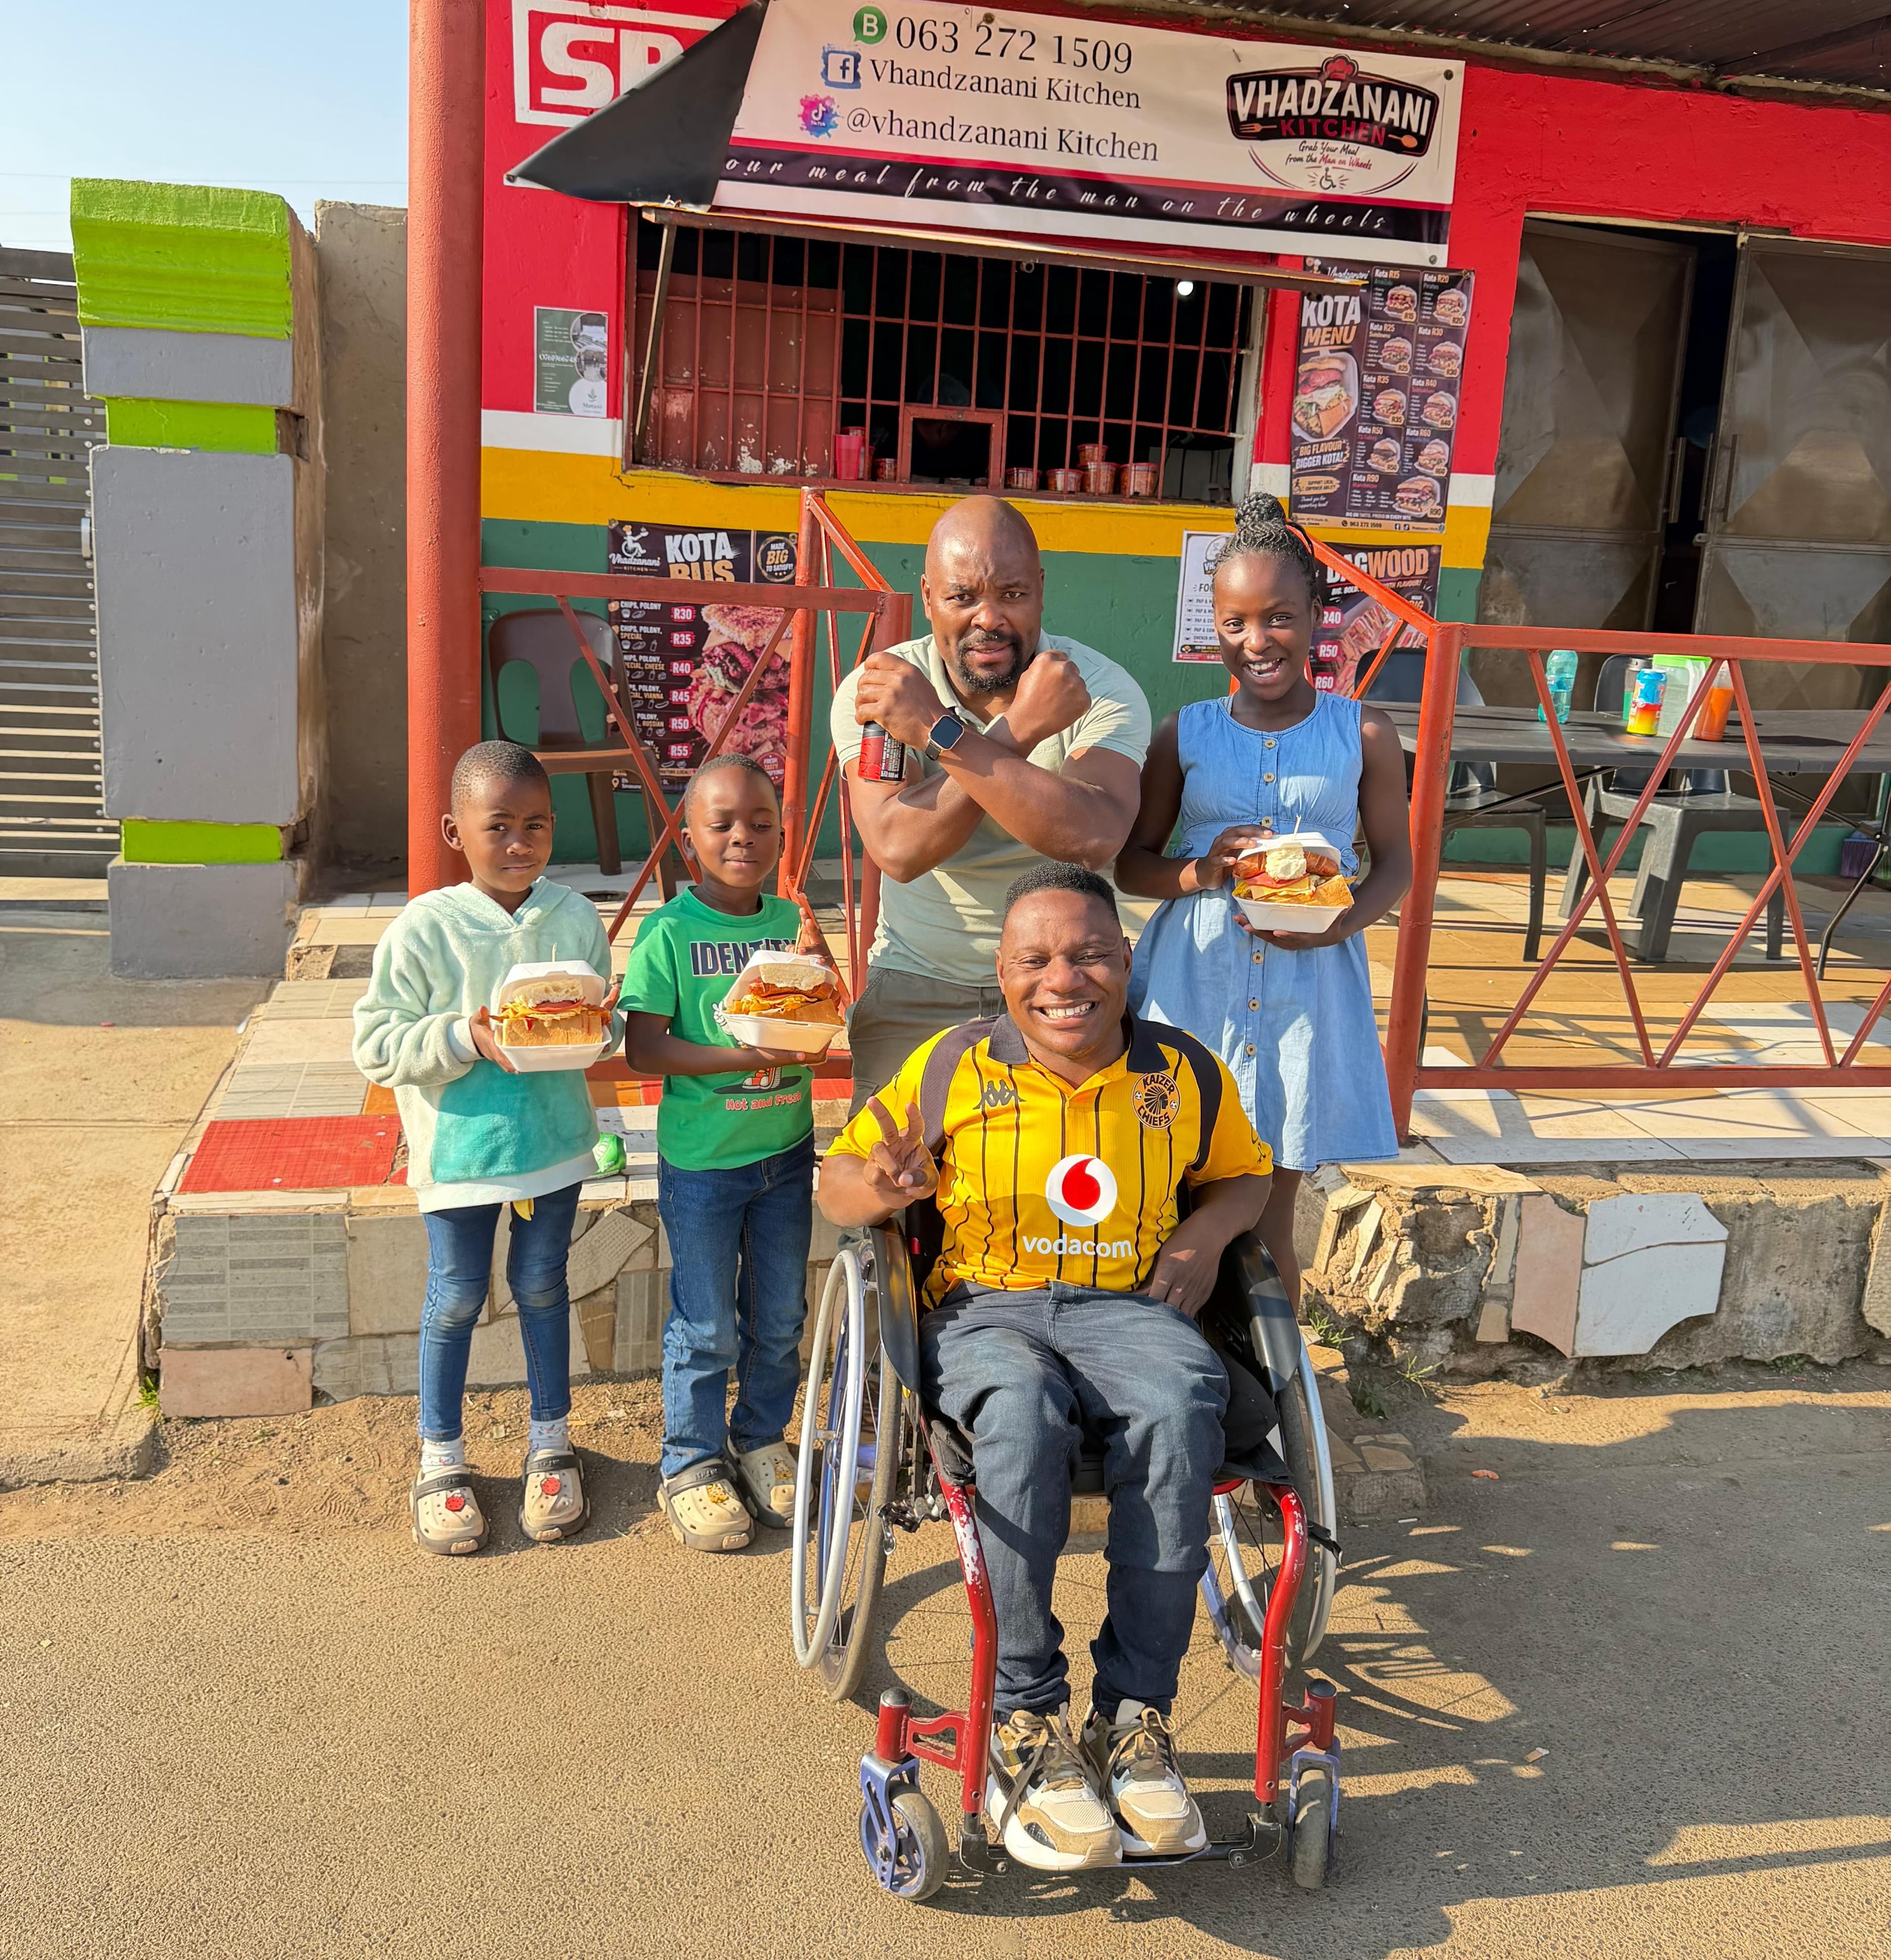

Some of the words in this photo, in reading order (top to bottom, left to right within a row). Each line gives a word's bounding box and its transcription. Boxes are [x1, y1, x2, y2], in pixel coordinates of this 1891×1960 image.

[896, 17, 958, 53] 063
[975, 25, 1036, 61] 272
[1053, 35, 1132, 74] 1509
[541, 22, 684, 108] SP
[870, 59, 1038, 98] Vhandzanani
[1046, 78, 1141, 109] Kitchen
[1234, 78, 1431, 136] VHADZANANI
[847, 107, 1048, 151] @vhandzanani
[1057, 129, 1158, 161] Kitchen
[1281, 118, 1386, 146] KITCHEN
[1299, 140, 1318, 152] Grab
[1320, 141, 1338, 154] Your
[1340, 144, 1360, 156] Meal
[1285, 154, 1304, 165] from
[1306, 154, 1317, 163] the
[1319, 154, 1336, 164] Man
[1349, 157, 1372, 170] Wheels
[809, 164, 890, 184] meal
[905, 168, 985, 198] from
[1011, 177, 1057, 201] the
[1080, 191, 1138, 209] man
[1162, 200, 1194, 213] on
[1217, 197, 1264, 221] the
[1284, 204, 1386, 229] wheels
[1375, 269, 1388, 278] Kota
[1389, 270, 1400, 279] R15
[1424, 273, 1437, 282] Kota
[1437, 274, 1449, 283] R20
[1302, 295, 1361, 327] KOTA
[1370, 322, 1383, 331] Kota
[1384, 323, 1395, 332] R25
[1419, 326, 1431, 335] Kota
[1304, 325, 1357, 347] MENU
[1363, 374, 1376, 383] Kota
[1377, 375, 1390, 384] R35
[1412, 378, 1425, 386] Kota
[1425, 379, 1437, 387] R40
[1358, 425, 1371, 434] Kota
[1372, 426, 1383, 435] R50
[1406, 428, 1419, 436] Kota
[1299, 445, 1311, 456] BIG
[1312, 440, 1342, 454] FLAVOUR
[1295, 455, 1322, 469] BIGGER
[1322, 452, 1343, 465] KOTA!
[665, 532, 734, 563] KOTA
[609, 553, 661, 566] Vhadzanani
[766, 549, 788, 565] BIG
[674, 608, 692, 620] R30
[1323, 611, 1341, 624] R40
[673, 634, 691, 645] R35
[1319, 644, 1338, 658] R50
[673, 662, 690, 674] R40
[1315, 676, 1334, 689] R60
[672, 690, 689, 702] R45
[671, 718, 689, 729] R50
[671, 745, 688, 756] R55
[1142, 1074, 1175, 1095] KAIZER
[726, 1098, 748, 1110] Hot
[751, 1096, 773, 1110] and
[775, 1091, 802, 1106] Fresh
[1138, 1105, 1171, 1126] CHIEFS
[1022, 1233, 1132, 1258] vodacom
